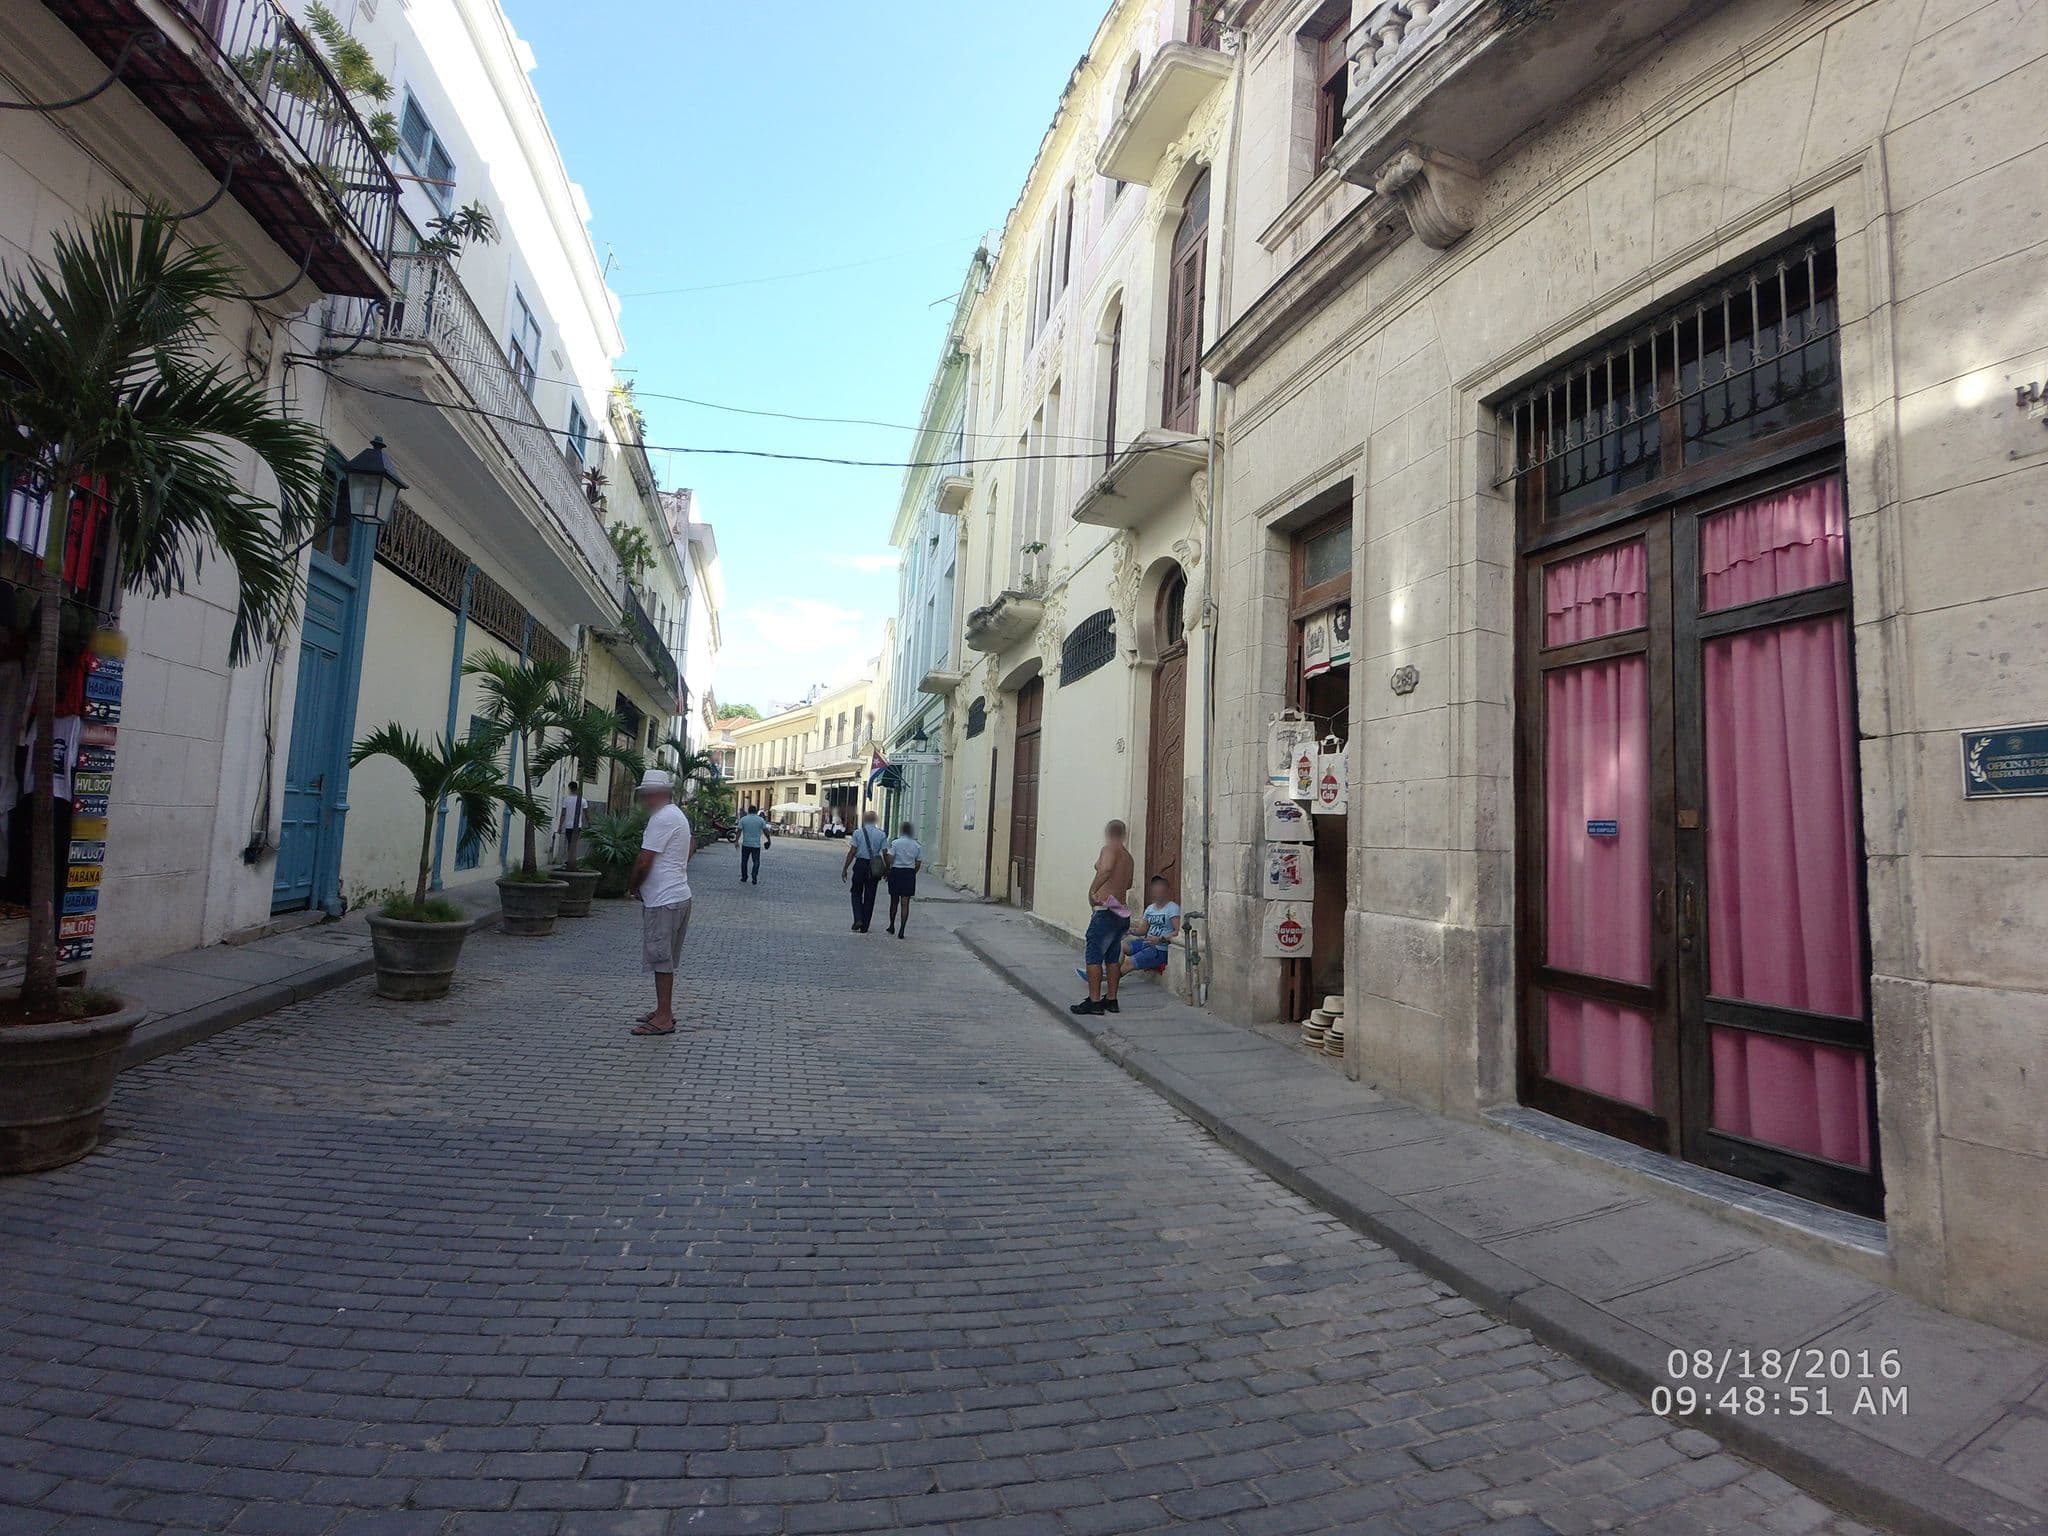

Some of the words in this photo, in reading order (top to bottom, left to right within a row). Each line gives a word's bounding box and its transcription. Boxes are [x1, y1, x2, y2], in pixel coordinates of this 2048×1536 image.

[86, 680, 122, 697] HABANA
[1987, 760, 2029, 770] OFICINA
[76, 778, 111, 792] HVL037
[69, 871, 101, 883] HABANA
[65, 896, 97, 908] HABANA
